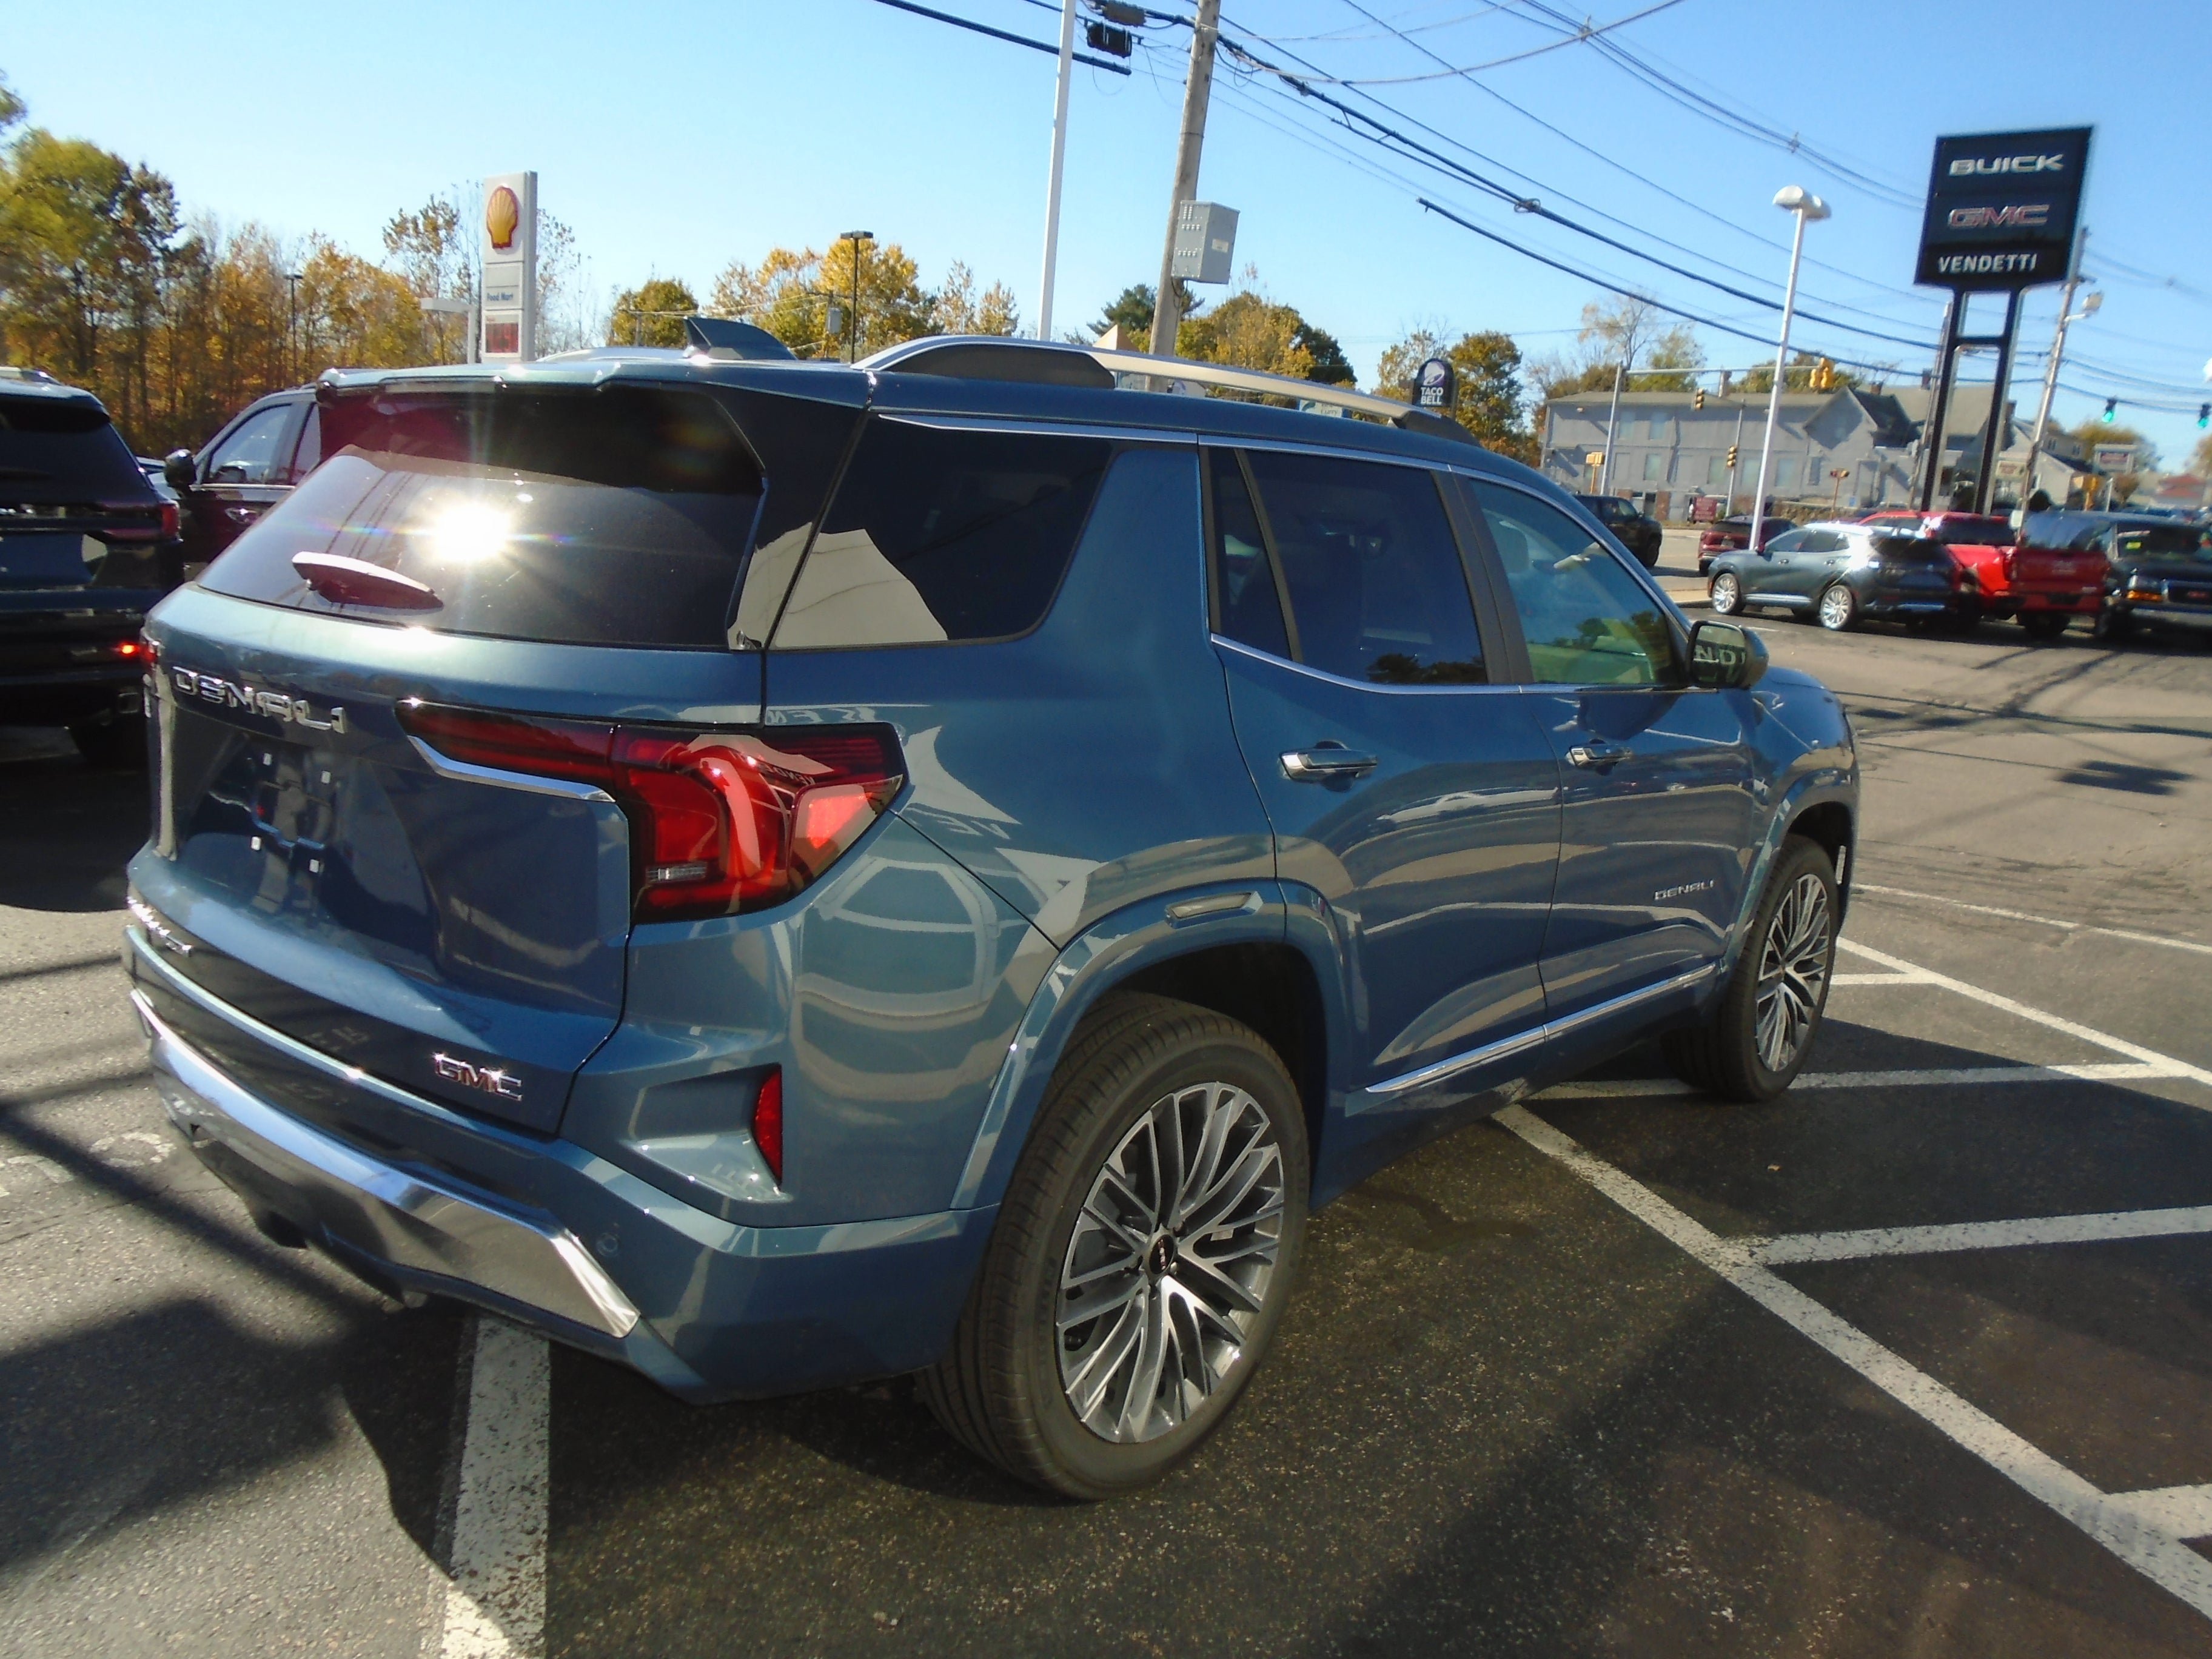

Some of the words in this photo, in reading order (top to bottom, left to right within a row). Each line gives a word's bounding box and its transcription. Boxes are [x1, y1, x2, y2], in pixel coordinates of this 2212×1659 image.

[1949, 153, 2064, 176] BUICK
[1947, 203, 2049, 229] GMC
[1938, 253, 2037, 273] VENDETTI
[1420, 386, 1444, 396] TACO
[1421, 395, 1442, 404] BELL
[172, 666, 347, 734] DENALI
[1654, 879, 1715, 900] DENALI
[433, 1052, 523, 1102] GMC
